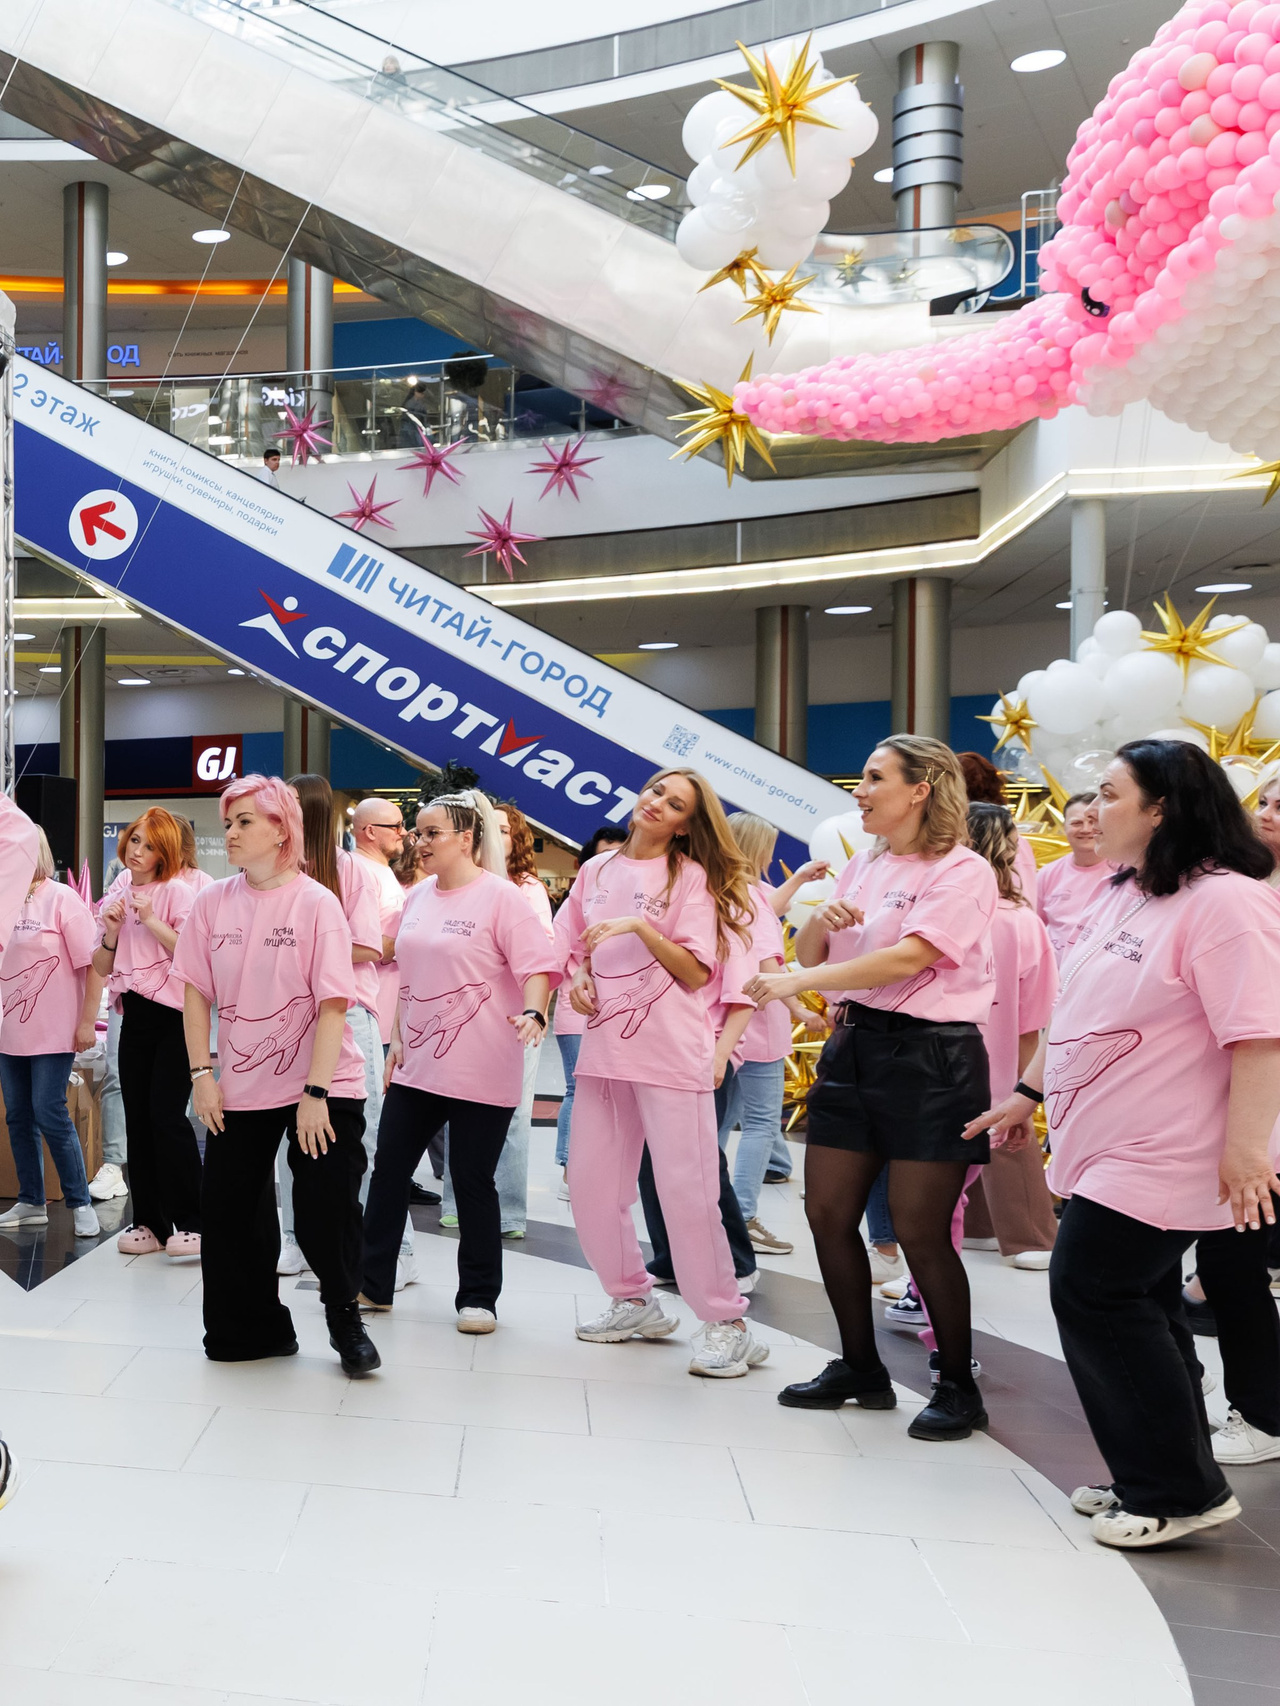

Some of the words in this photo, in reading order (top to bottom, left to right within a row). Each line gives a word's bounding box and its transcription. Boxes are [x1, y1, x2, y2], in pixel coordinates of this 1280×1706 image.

[13, 373, 28, 398] 2
[30, 390, 100, 437] этаж
[142, 459, 184, 487] игрушки,
[186, 483, 234, 514] сувениры,
[236, 509, 278, 537] подарки
[149, 448, 178, 470] книги,
[180, 466, 223, 493] комиксы,
[225, 489, 285, 525] канцелярия
[388, 576, 613, 719] ЧИТАЙ-ГОРОД
[704, 751, 818, 815] www.chitai-gorod.ru
